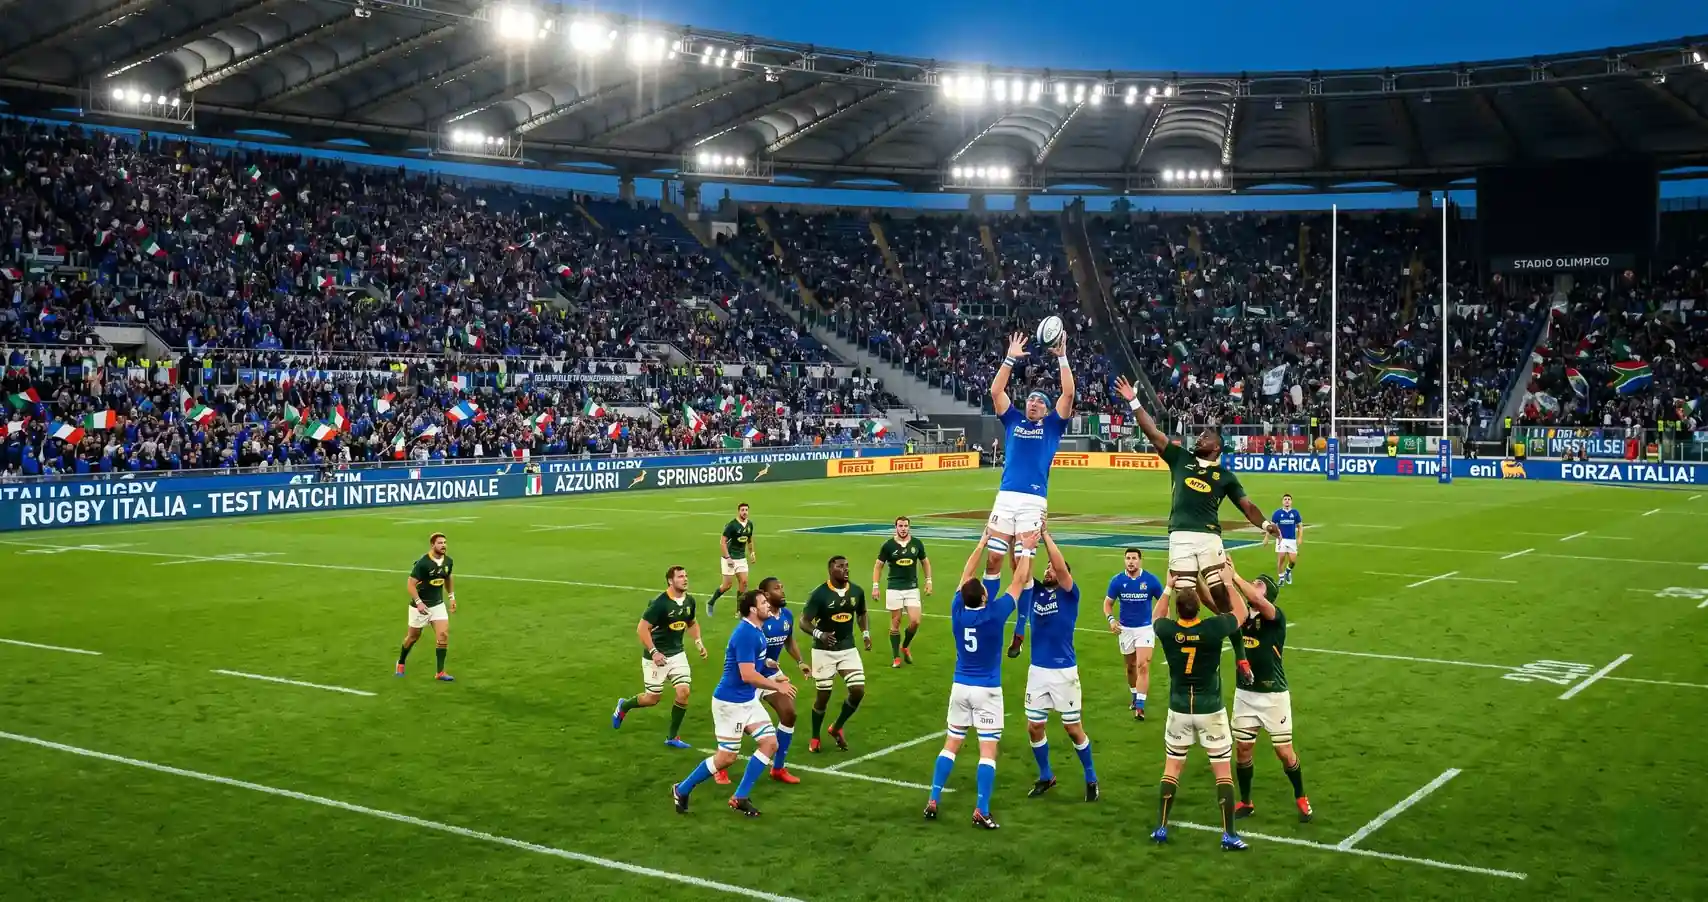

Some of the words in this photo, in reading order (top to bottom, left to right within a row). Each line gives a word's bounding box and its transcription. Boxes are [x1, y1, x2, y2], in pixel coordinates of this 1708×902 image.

[1514, 259, 1553, 269] STADIO
[1556, 256, 1610, 268] OLIMPICO
[838, 459, 875, 474] PIRELLI
[889, 456, 924, 471] PIRELLI
[938, 454, 970, 469] PIRELLI
[1053, 453, 1089, 467] RELLI
[1109, 454, 1160, 469] PIRELLI
[1234, 457, 1264, 471] SUD
[1267, 457, 1321, 472] AFRICA
[1325, 458, 1378, 473] UGBY
[657, 465, 744, 487] SPRINGBOKS
[1469, 461, 1497, 477] eni
[1561, 463, 1622, 481] FORZA
[1627, 465, 1695, 482] ITALIA!
[554, 471, 619, 493] AZZURRI
[1189, 479, 1207, 491] MTN
[20, 499, 106, 526] RUGBY
[112, 495, 188, 520] ITALIA
[208, 490, 262, 514] TEST
[267, 486, 337, 510] MATCH
[343, 478, 499, 506] INTERNAZIONALE
[963, 627, 978, 653] 5
[1180, 646, 1197, 675] 7
